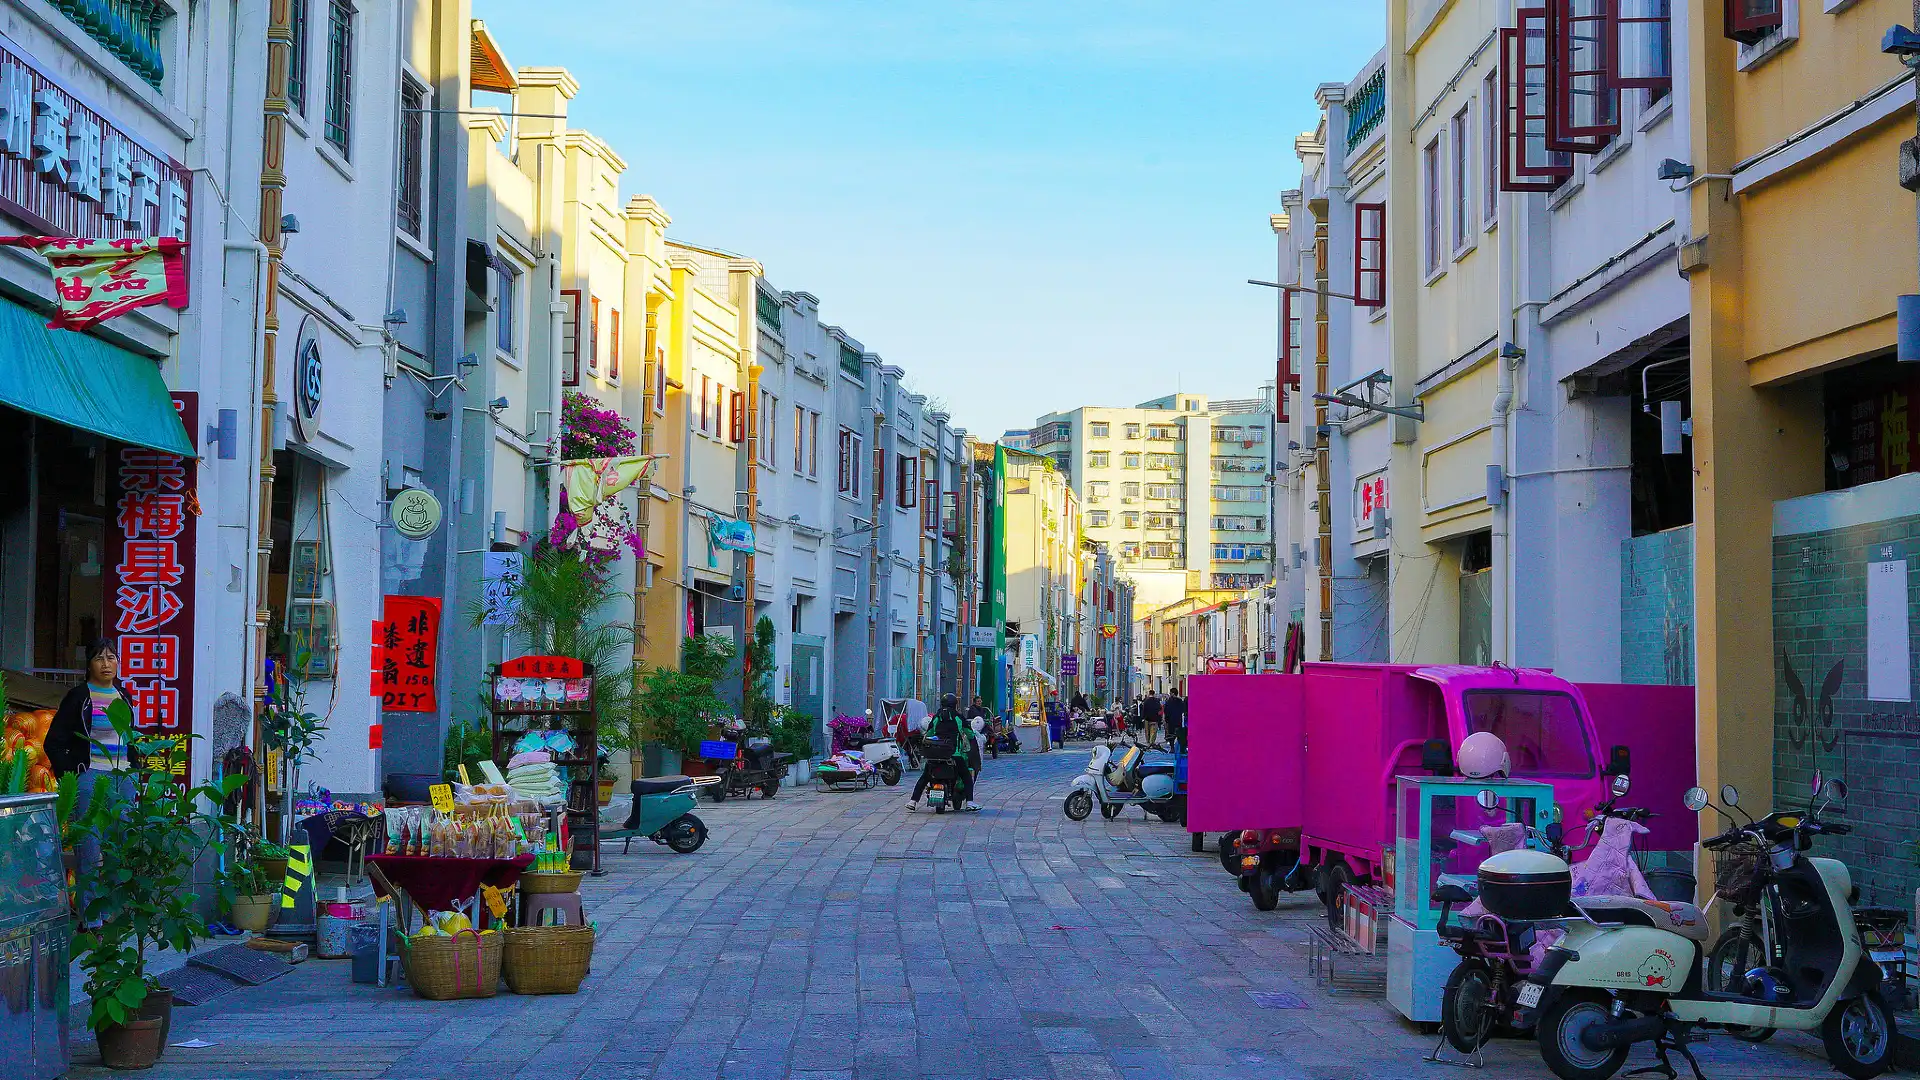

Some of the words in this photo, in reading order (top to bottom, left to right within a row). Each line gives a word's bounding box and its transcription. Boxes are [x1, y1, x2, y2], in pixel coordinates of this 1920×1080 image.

[117, 400, 185, 728] 宗梅县沙田柚
